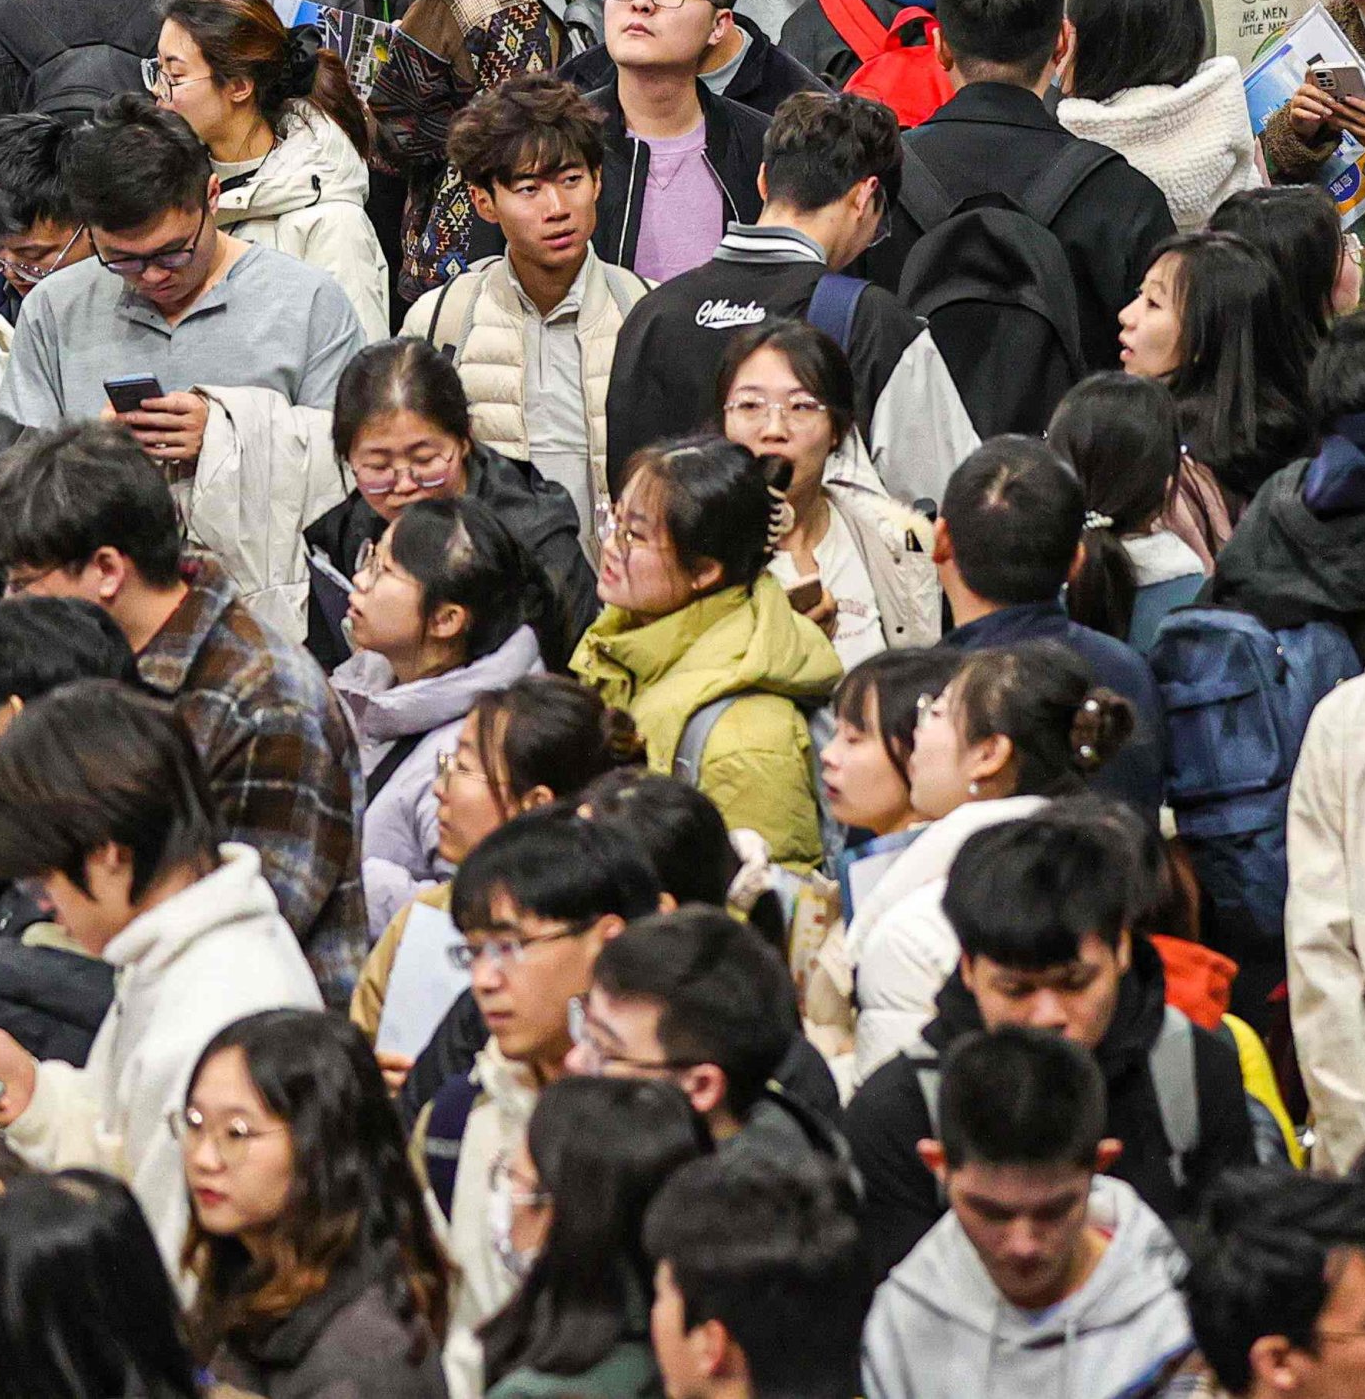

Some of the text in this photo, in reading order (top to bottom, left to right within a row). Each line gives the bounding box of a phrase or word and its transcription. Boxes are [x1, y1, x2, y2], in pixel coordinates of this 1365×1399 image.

[1262, 6, 1288, 20] MEN
[1239, 24, 1264, 38] LITTLE
[695, 299, 767, 327] Matcha
